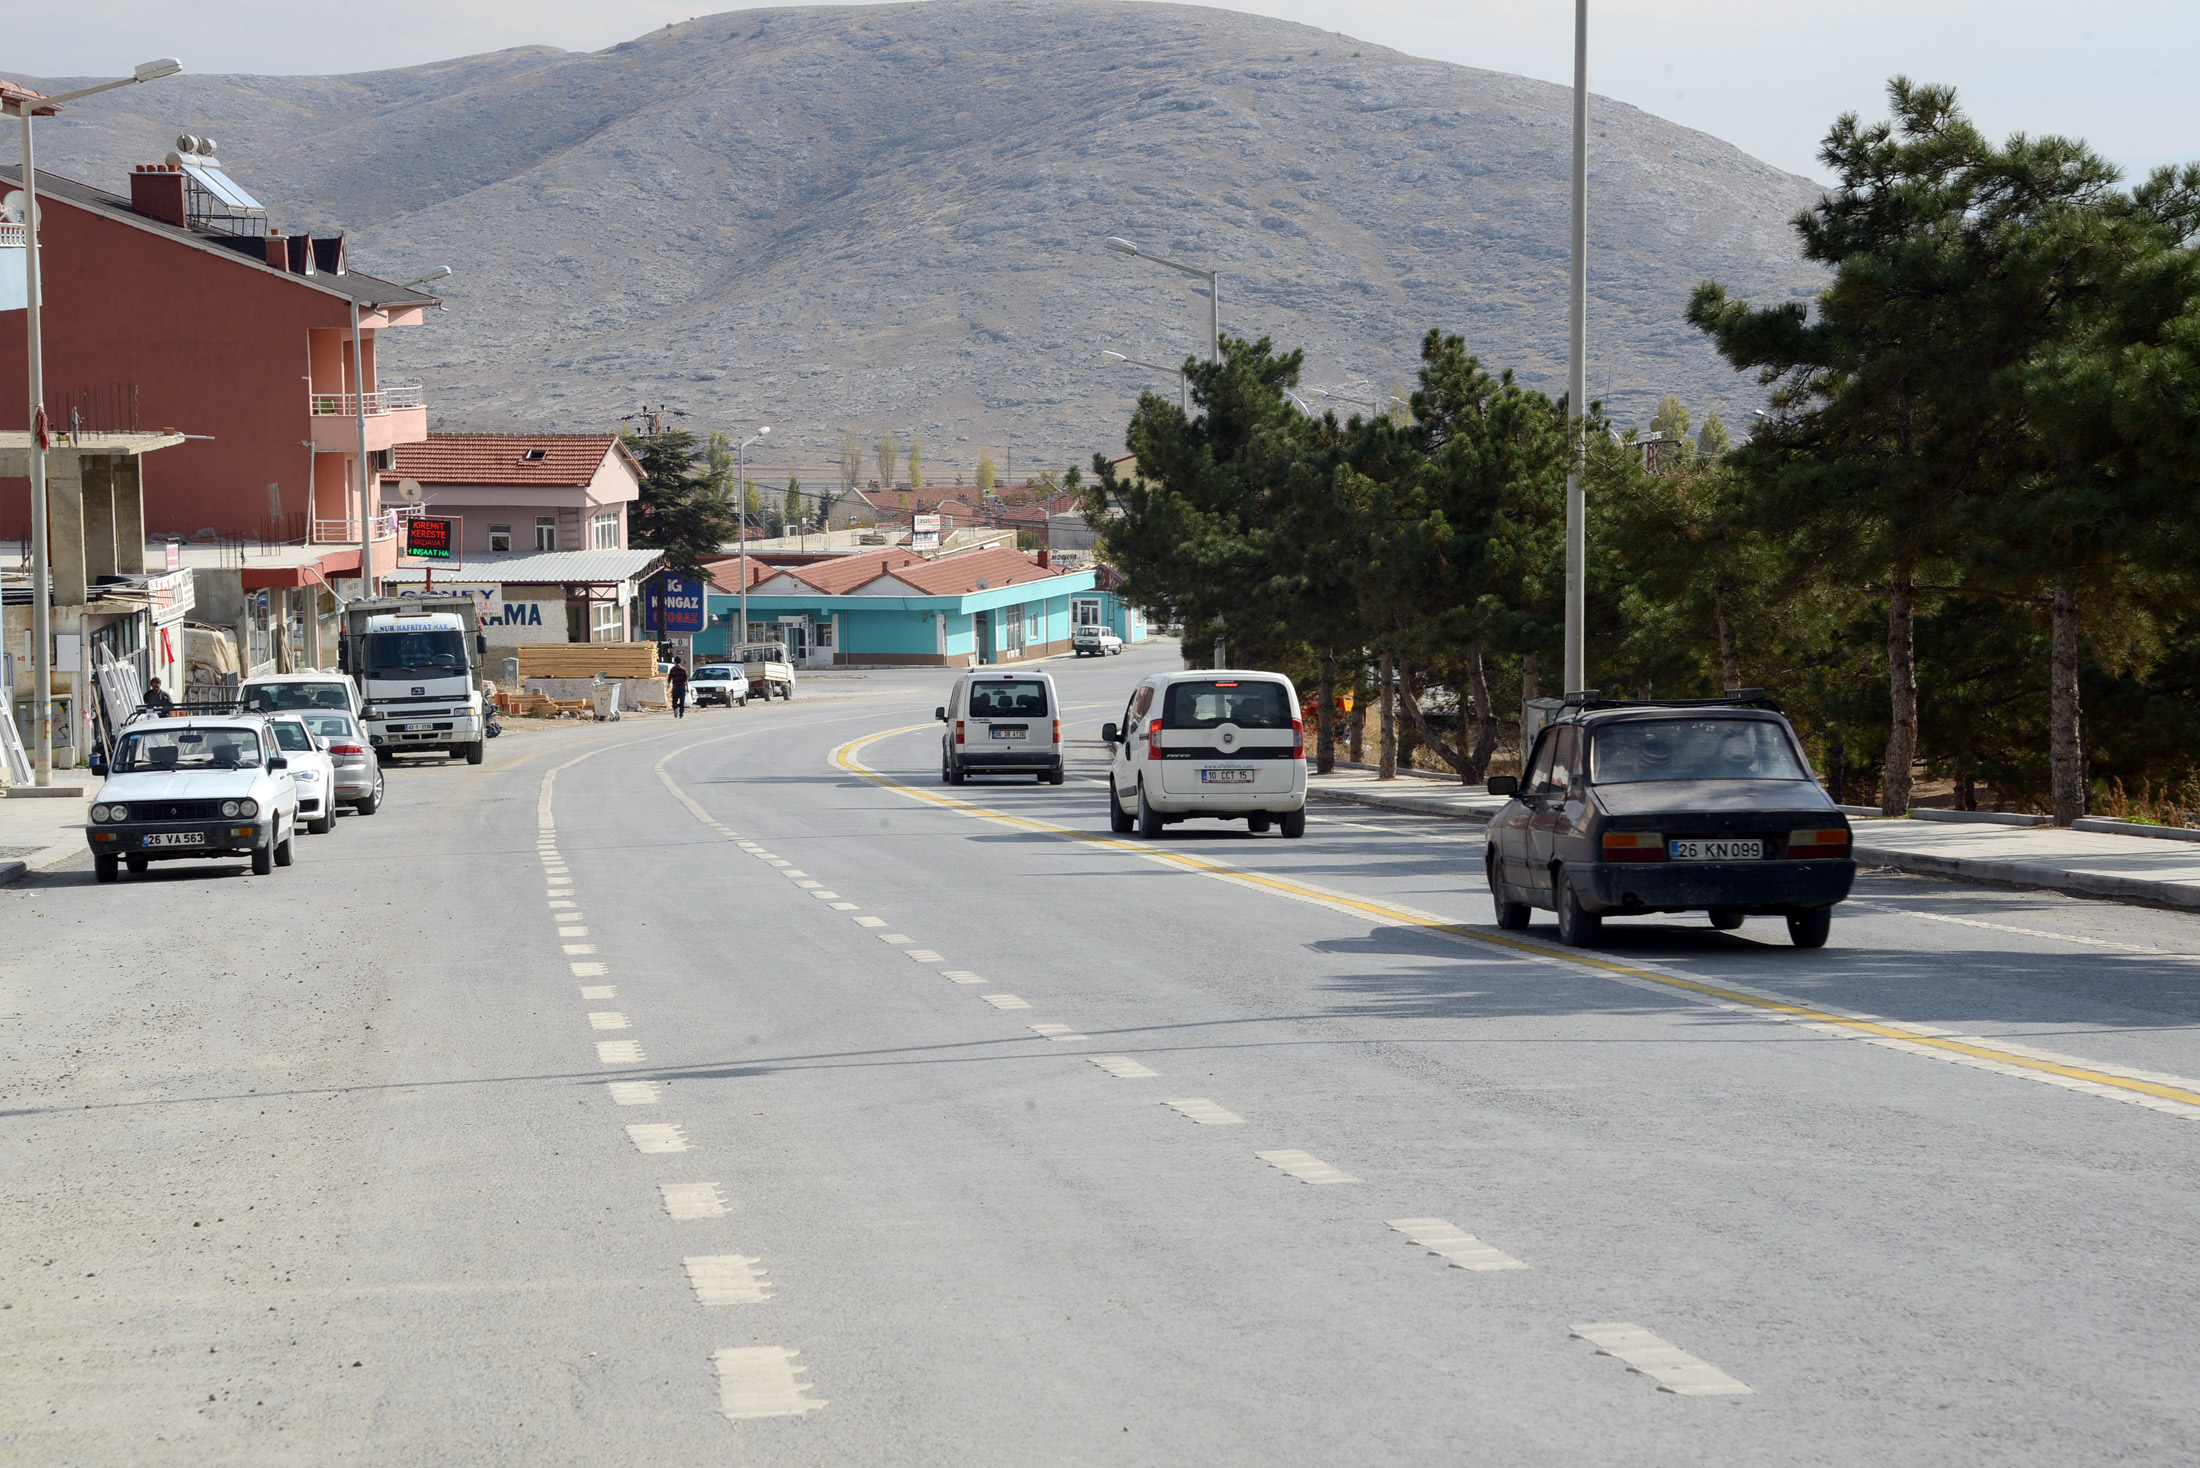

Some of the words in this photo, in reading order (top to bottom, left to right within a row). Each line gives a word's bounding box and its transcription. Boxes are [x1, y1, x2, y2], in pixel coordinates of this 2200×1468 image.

[413, 521, 445, 530] KİREMİT
[411, 529, 446, 539] KERESTE
[400, 589, 495, 600] GNEY
[476, 601, 499, 612] ŞAAT
[651, 596, 699, 609] KNGAZ
[653, 611, 698, 623] OOGAZ
[1208, 771, 1217, 780] 10
[1221, 771, 1235, 780] CCT
[1239, 771, 1247, 780] 15
[148, 835, 161, 845] 26
[166, 834, 181, 844] VA
[183, 833, 203, 844] 563
[1679, 843, 1698, 858] 26
[1705, 843, 1728, 858] KN
[1731, 842, 1760, 857] 099
